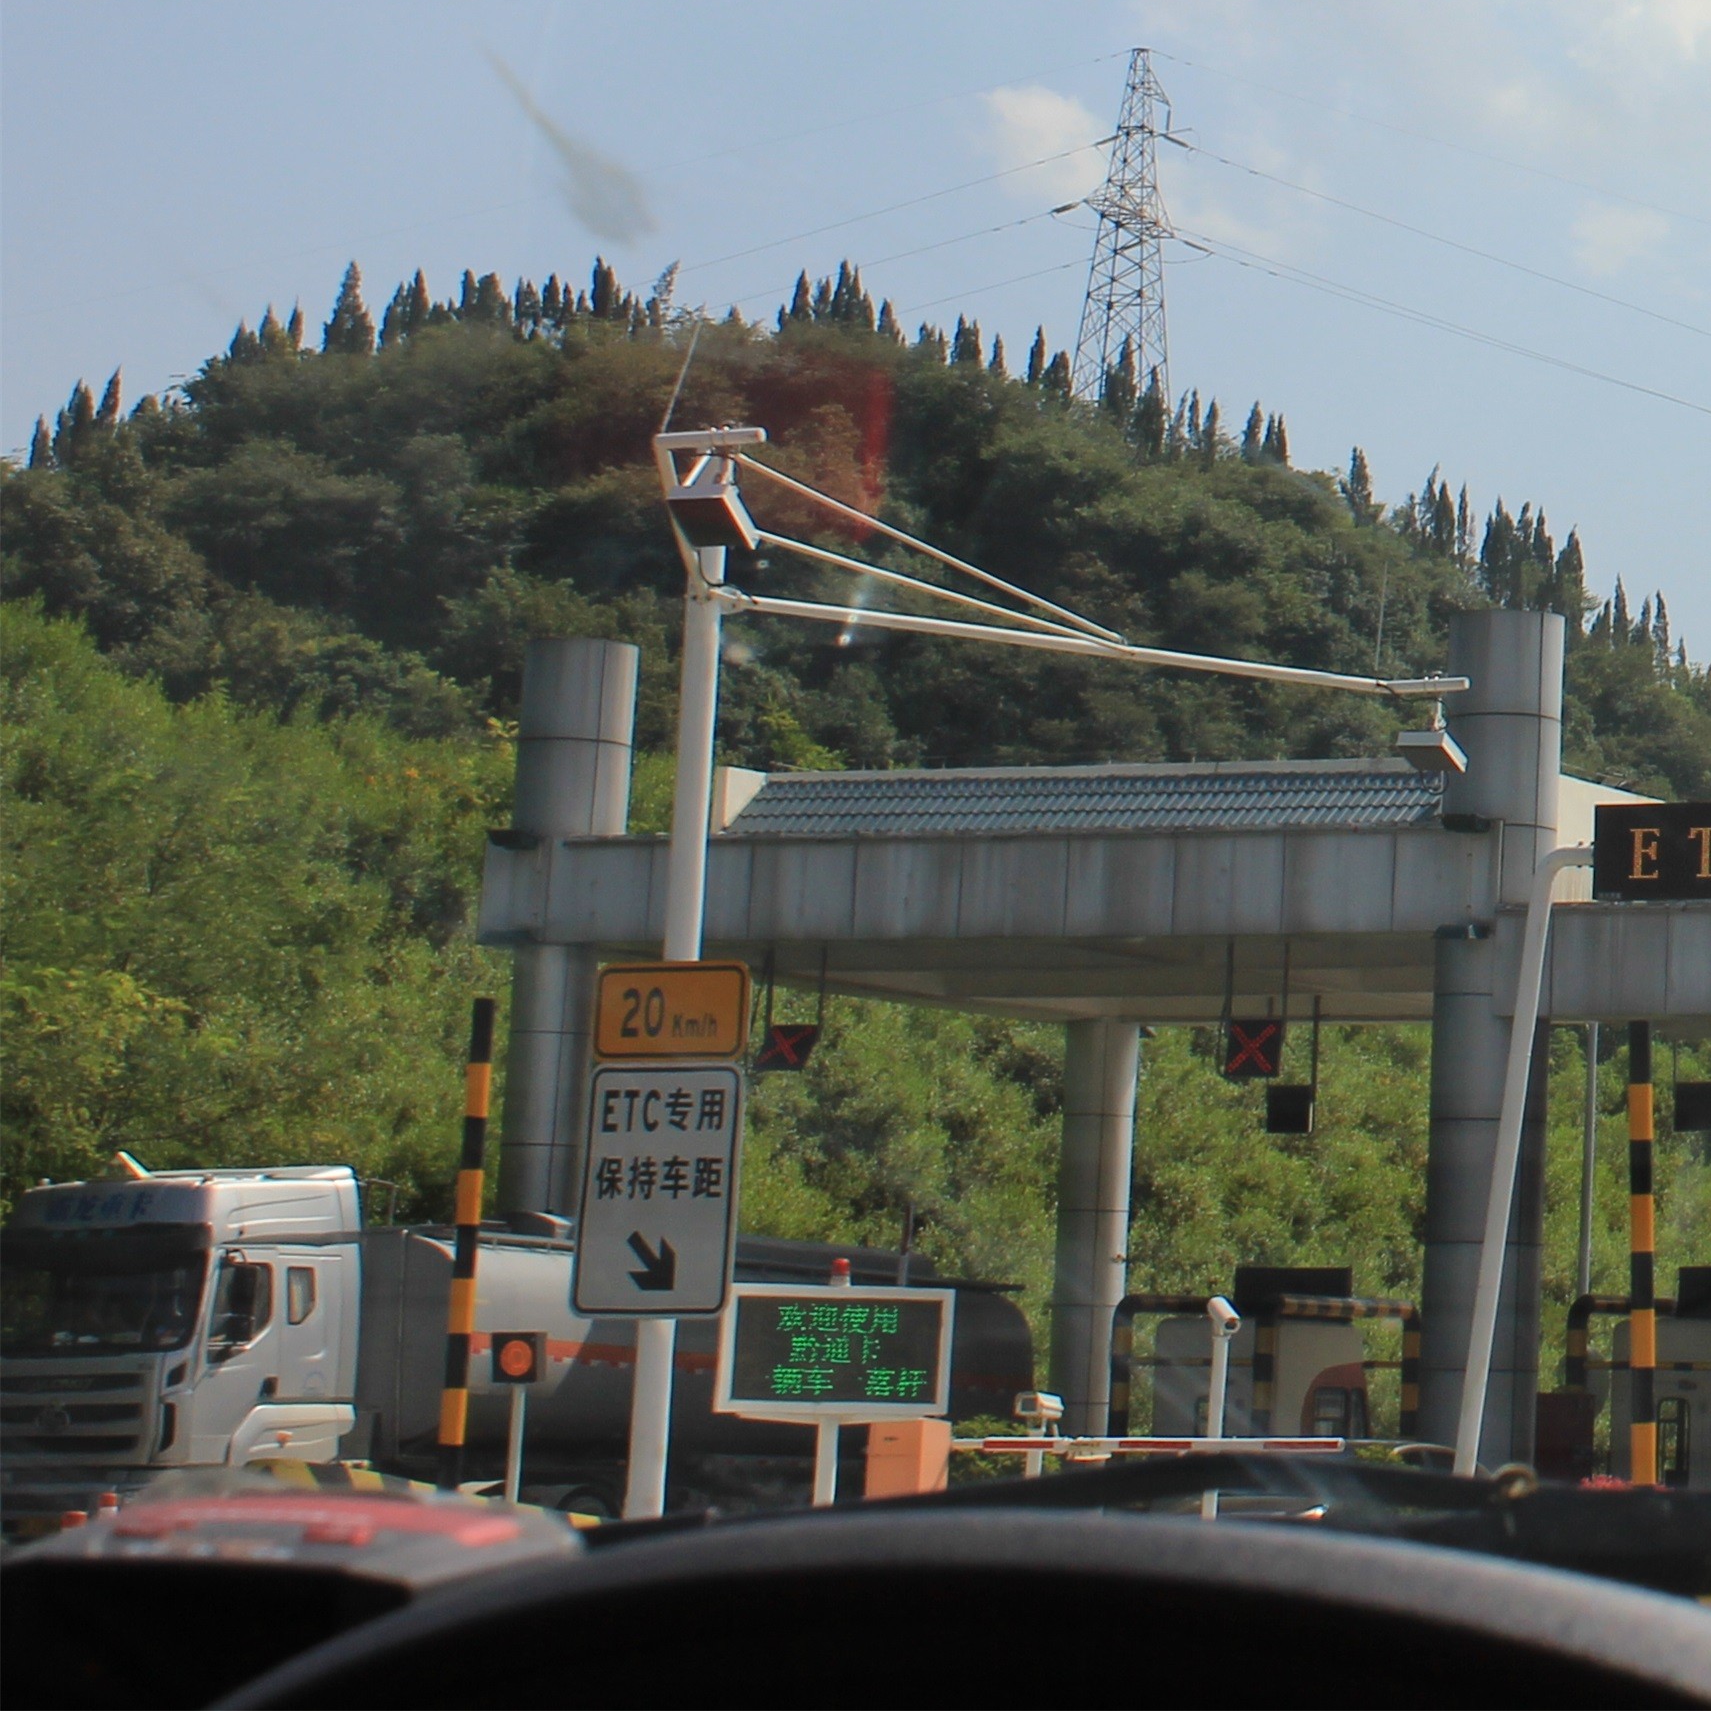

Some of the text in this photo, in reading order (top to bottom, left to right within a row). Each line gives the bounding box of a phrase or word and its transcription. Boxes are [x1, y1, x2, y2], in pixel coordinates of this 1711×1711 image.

[621, 987, 665, 1038] 20
[601, 1087, 726, 1133] ETC专用
[596, 1155, 724, 1201] 保持车距
